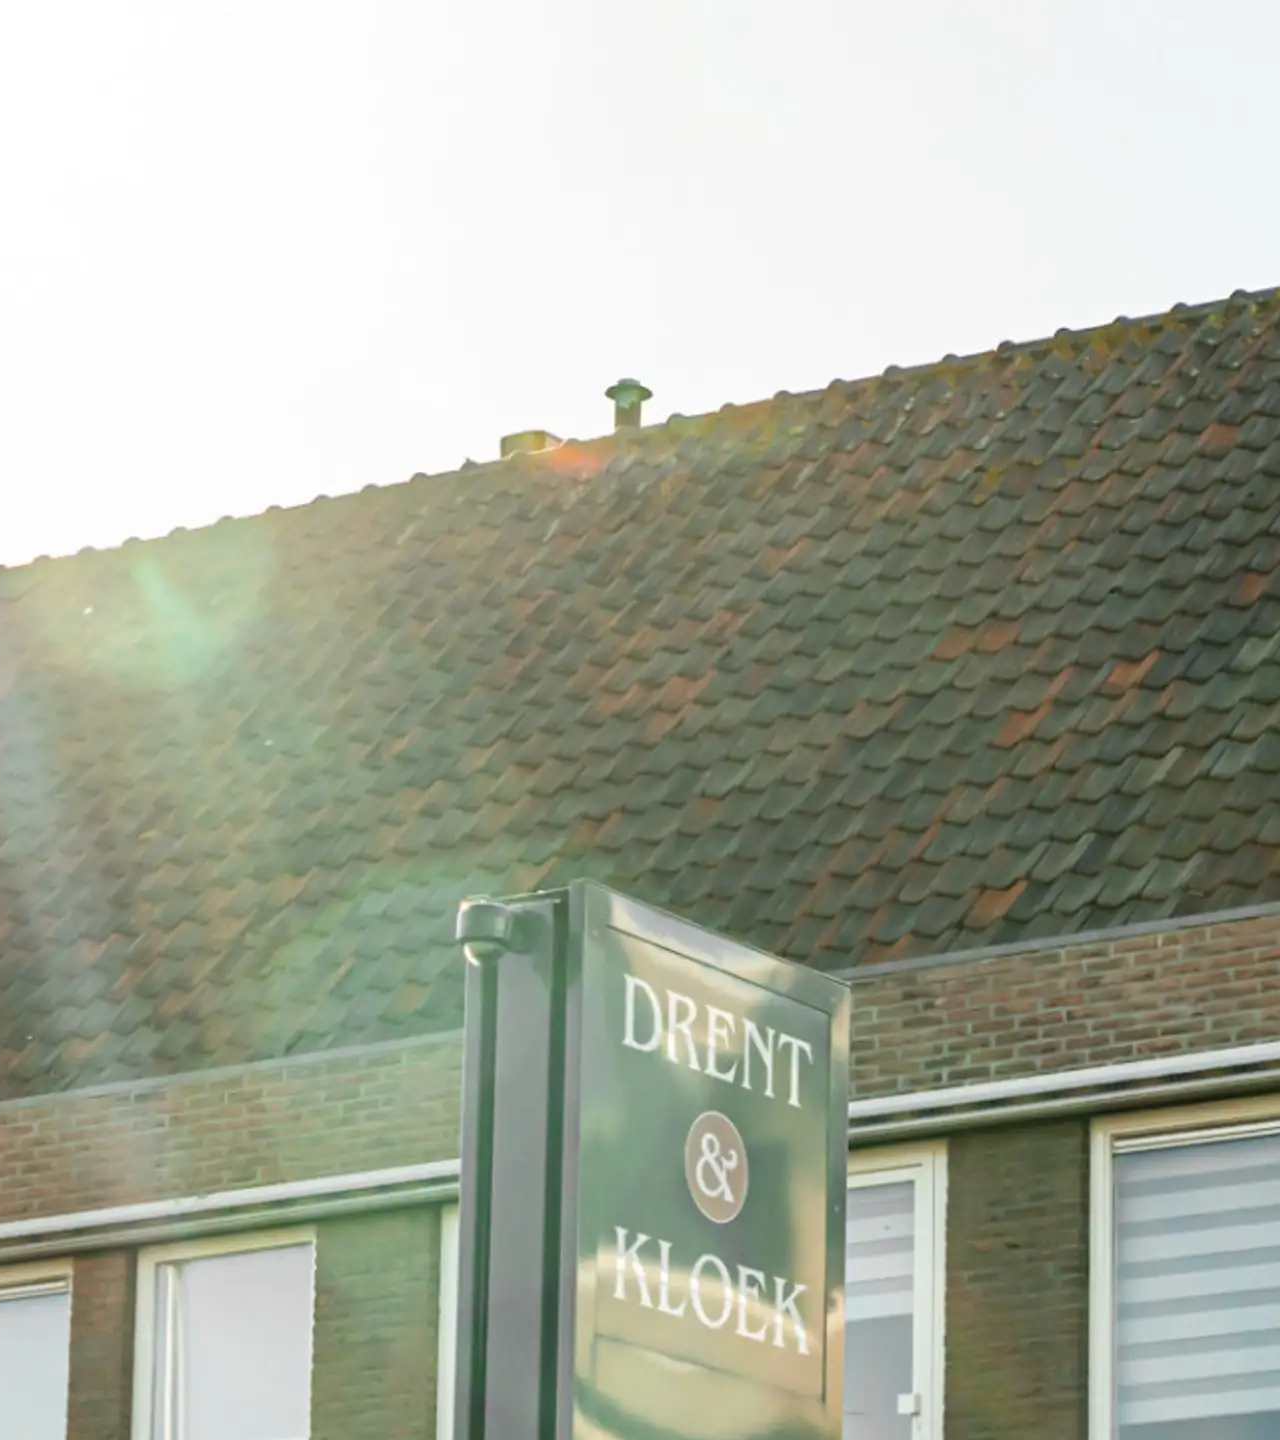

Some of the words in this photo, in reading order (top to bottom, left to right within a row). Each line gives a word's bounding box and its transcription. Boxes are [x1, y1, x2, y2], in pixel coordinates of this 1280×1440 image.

[621, 973, 814, 1108] DRENT
[695, 1132, 738, 1203] &
[612, 1225, 810, 1356] KLOEK
